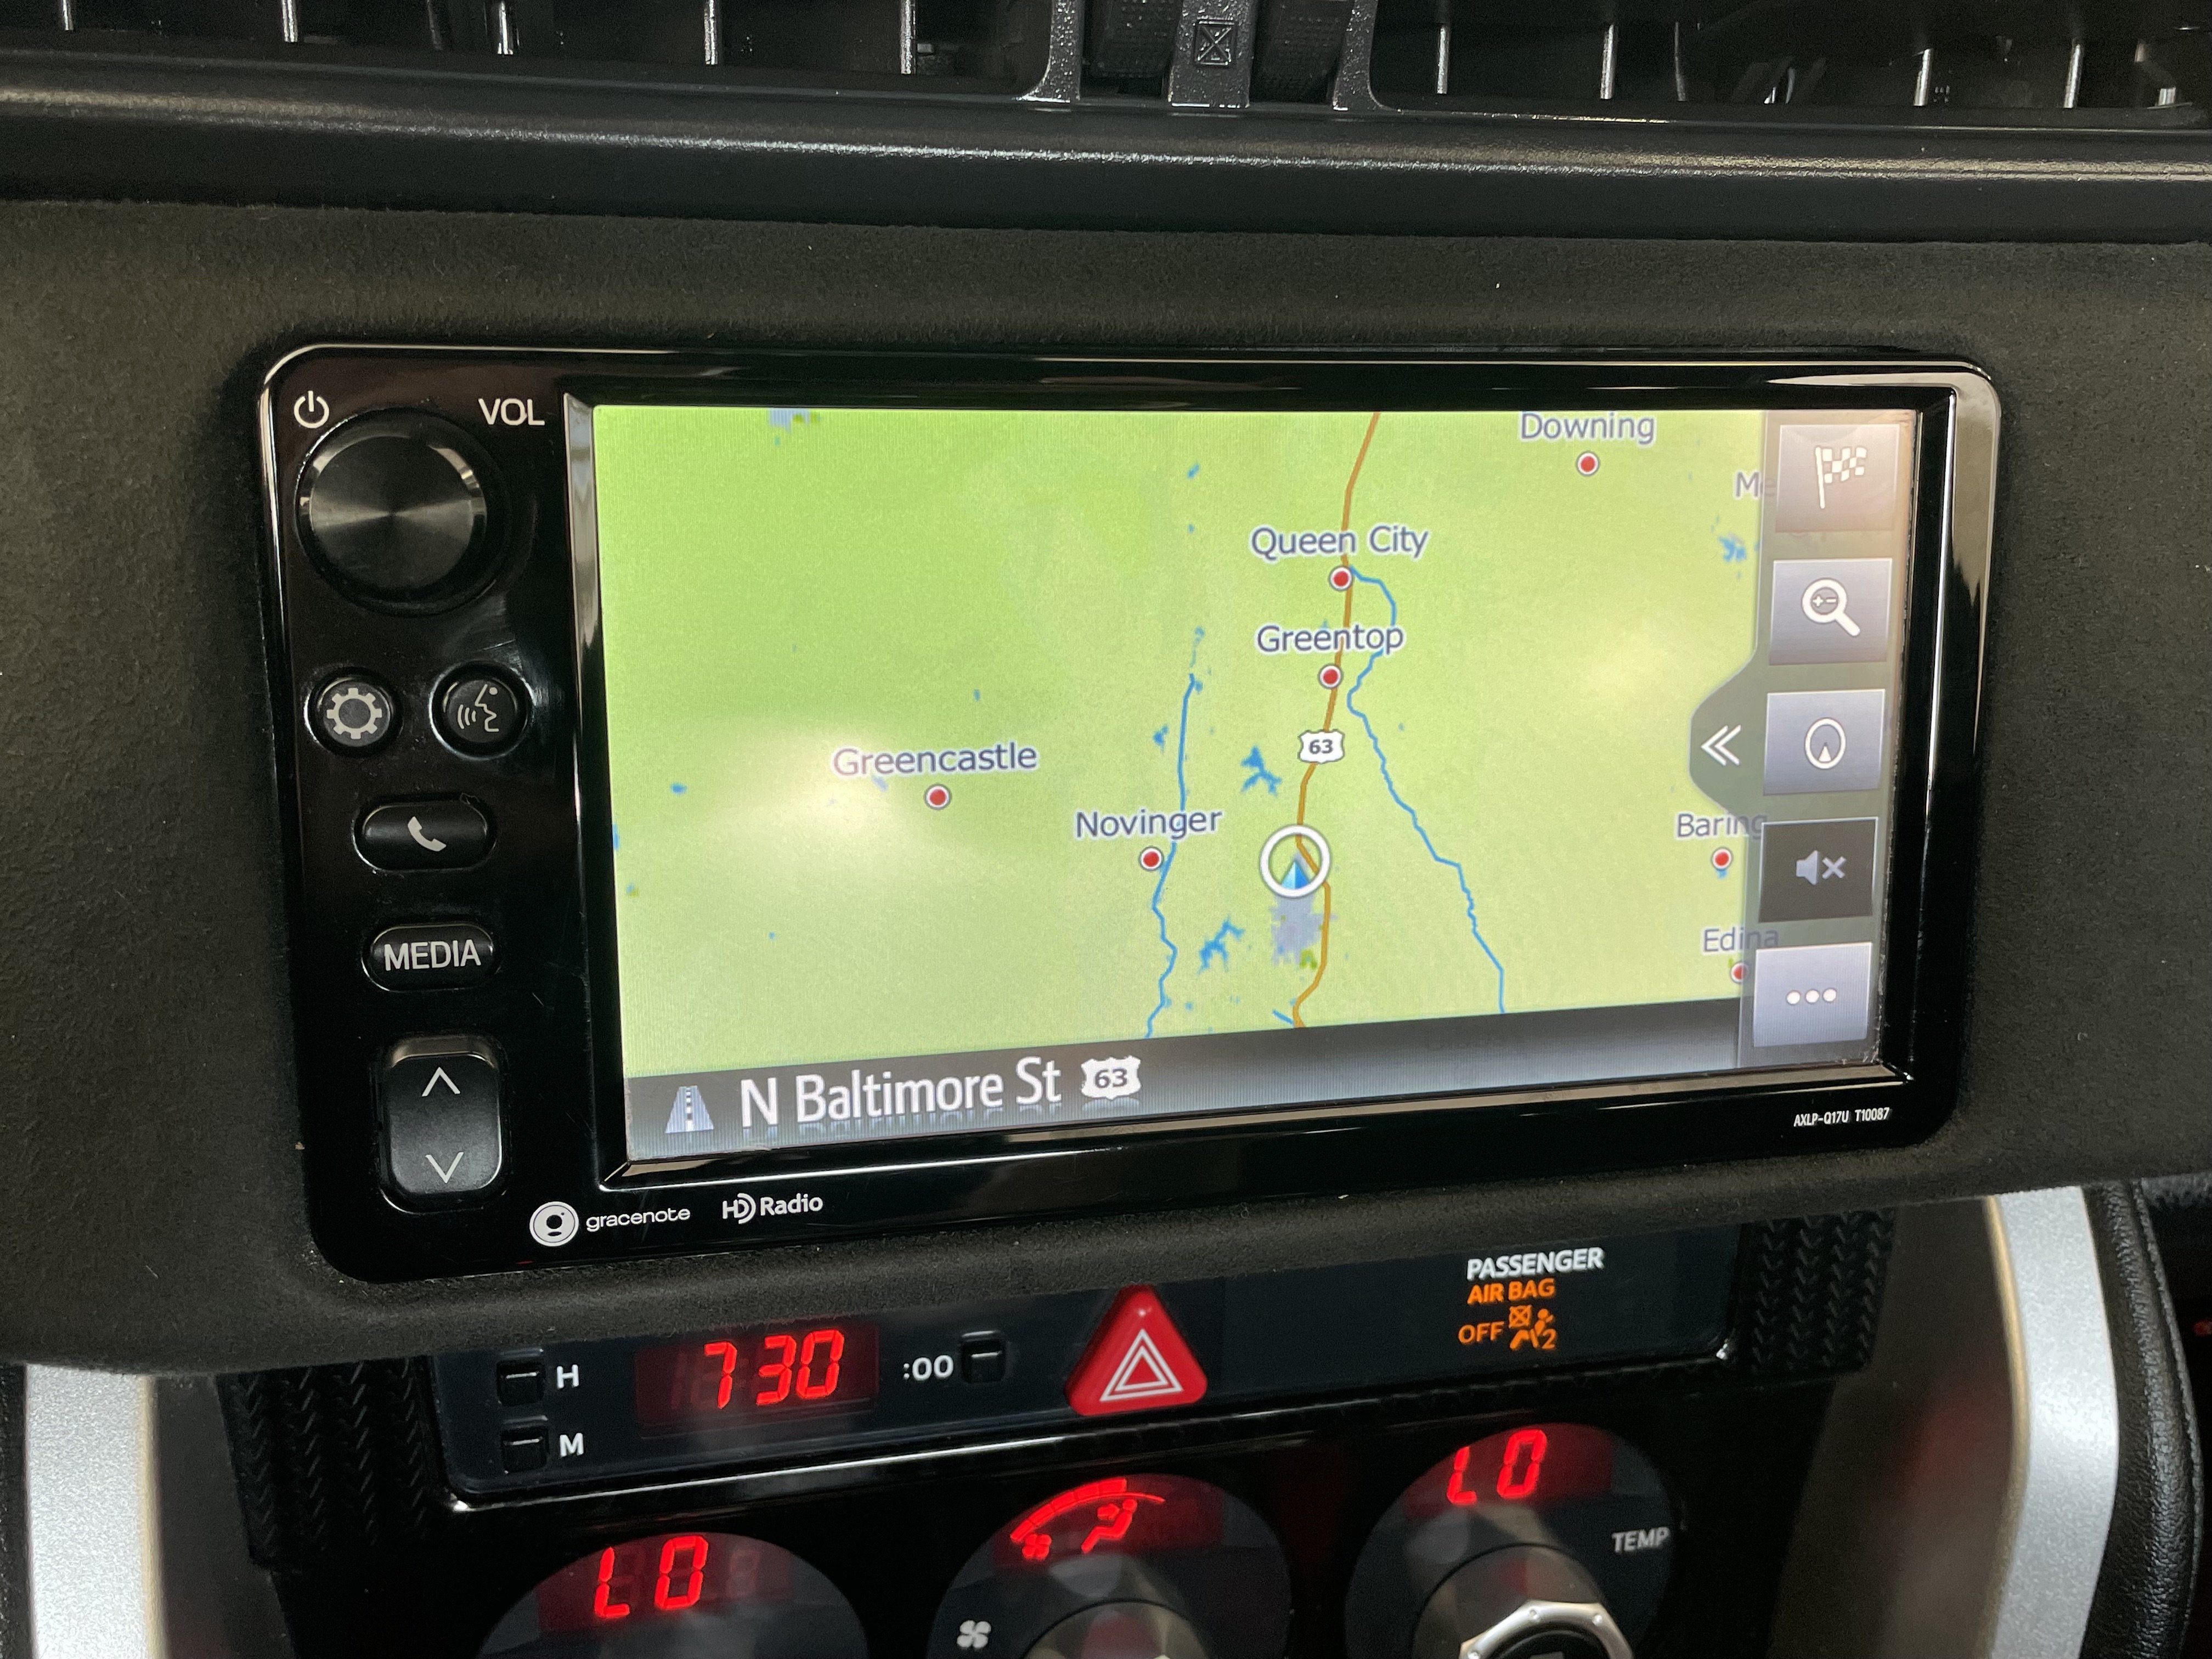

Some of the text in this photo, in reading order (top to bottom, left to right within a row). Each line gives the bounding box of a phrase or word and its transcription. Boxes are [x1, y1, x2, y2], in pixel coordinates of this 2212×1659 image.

[478, 398, 545, 426] VOL
[1520, 411, 1656, 445] Downing
[1251, 525, 1429, 560] Queen City
[1257, 624, 1404, 654] Greentop
[832, 742, 1038, 776] Greencastle
[1308, 738, 1334, 755] 63
[1075, 809, 1222, 840] Novinger
[1677, 813, 1769, 839] Baring
[1703, 926, 1779, 952] Edina
[384, 939, 481, 971] MEDIA
[1097, 1067, 1127, 1089] 63
[741, 1056, 1062, 1129] N Baltimore St
[1793, 1107, 1891, 1127] AXLP-Q17U T10087
[586, 1207, 691, 1232] gracenote
[723, 1193, 823, 1224] HD Radio
[1466, 1246, 1606, 1282] PASSENGER
[1467, 1277, 1556, 1305] AIR BAG
[1458, 1320, 1505, 1344] OFF
[556, 1363, 580, 1388] H
[558, 1431, 584, 1459] M
[1611, 1526, 1672, 1554] TEMP
